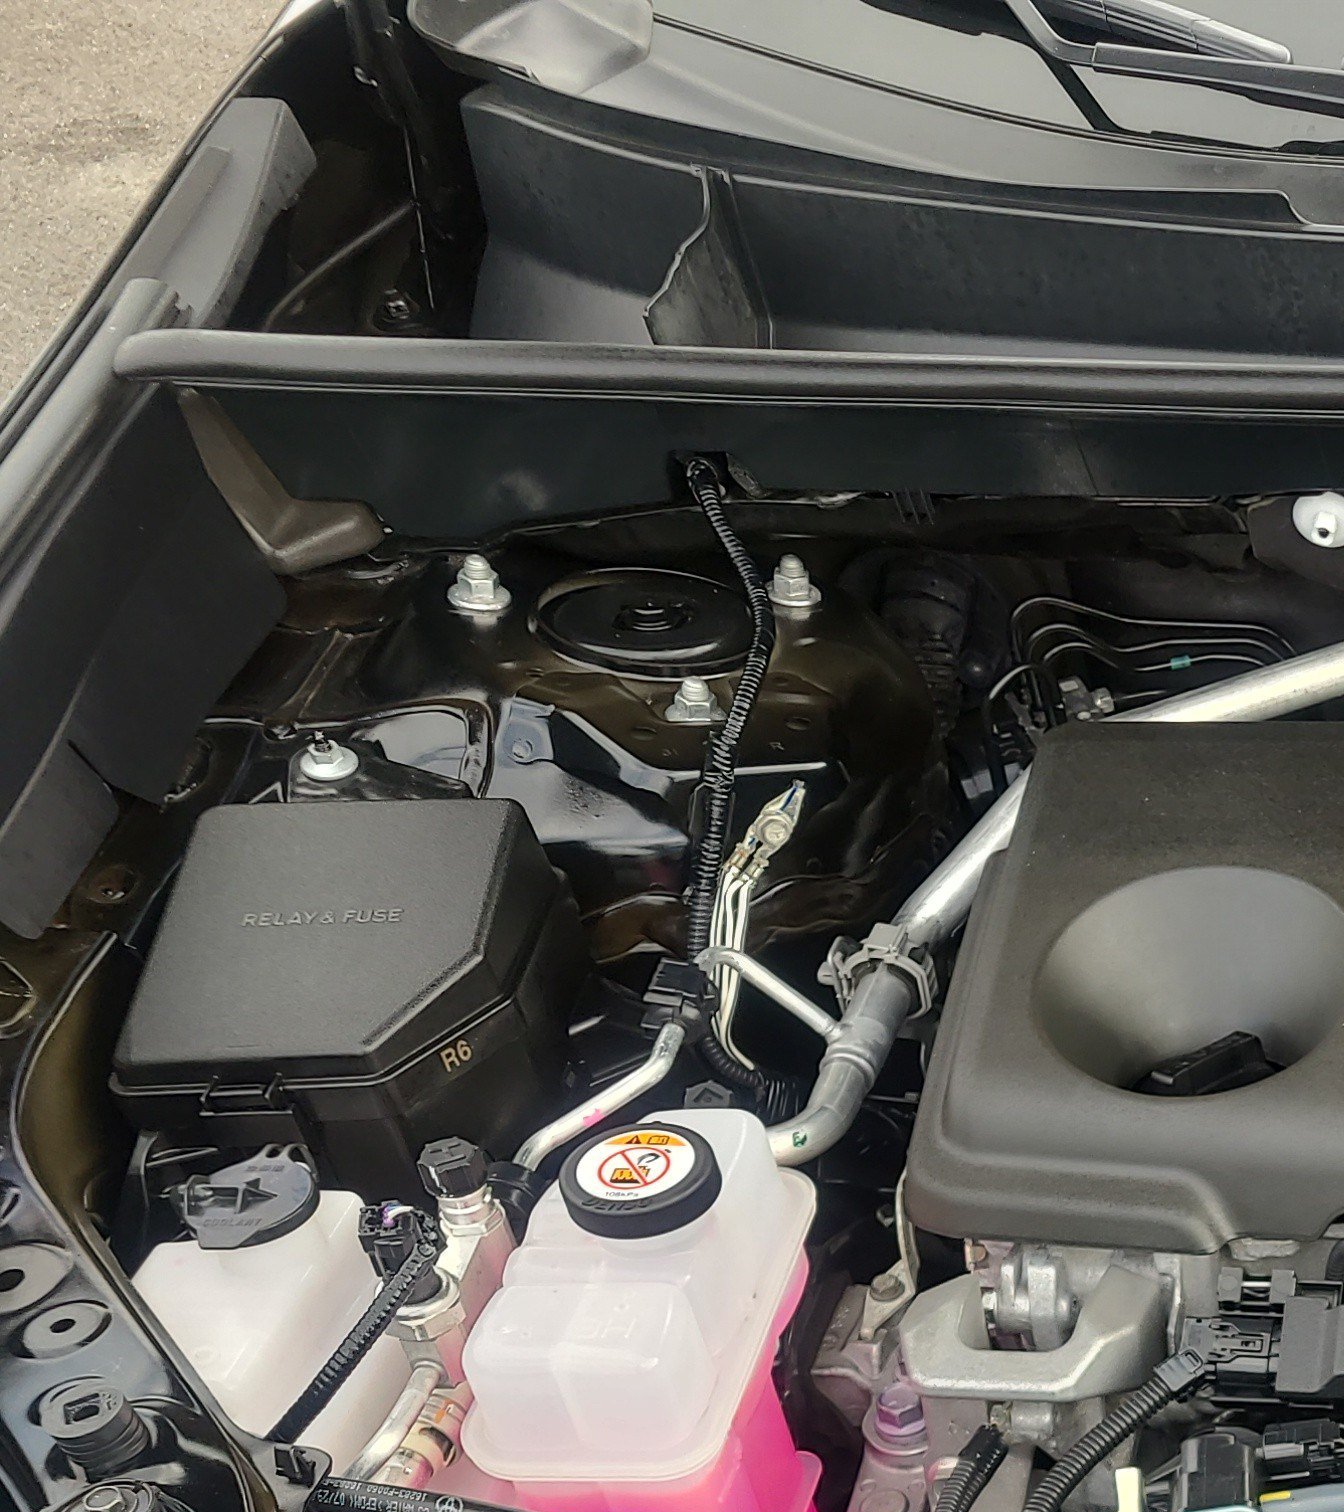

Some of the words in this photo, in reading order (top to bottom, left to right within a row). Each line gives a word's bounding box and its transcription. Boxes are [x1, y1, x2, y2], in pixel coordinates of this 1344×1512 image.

[241, 911, 318, 928] RELAY
[320, 911, 336, 925] &
[342, 908, 404, 924] FUSE
[440, 1040, 472, 1073] R6
[203, 1217, 263, 1228] COOLANT
